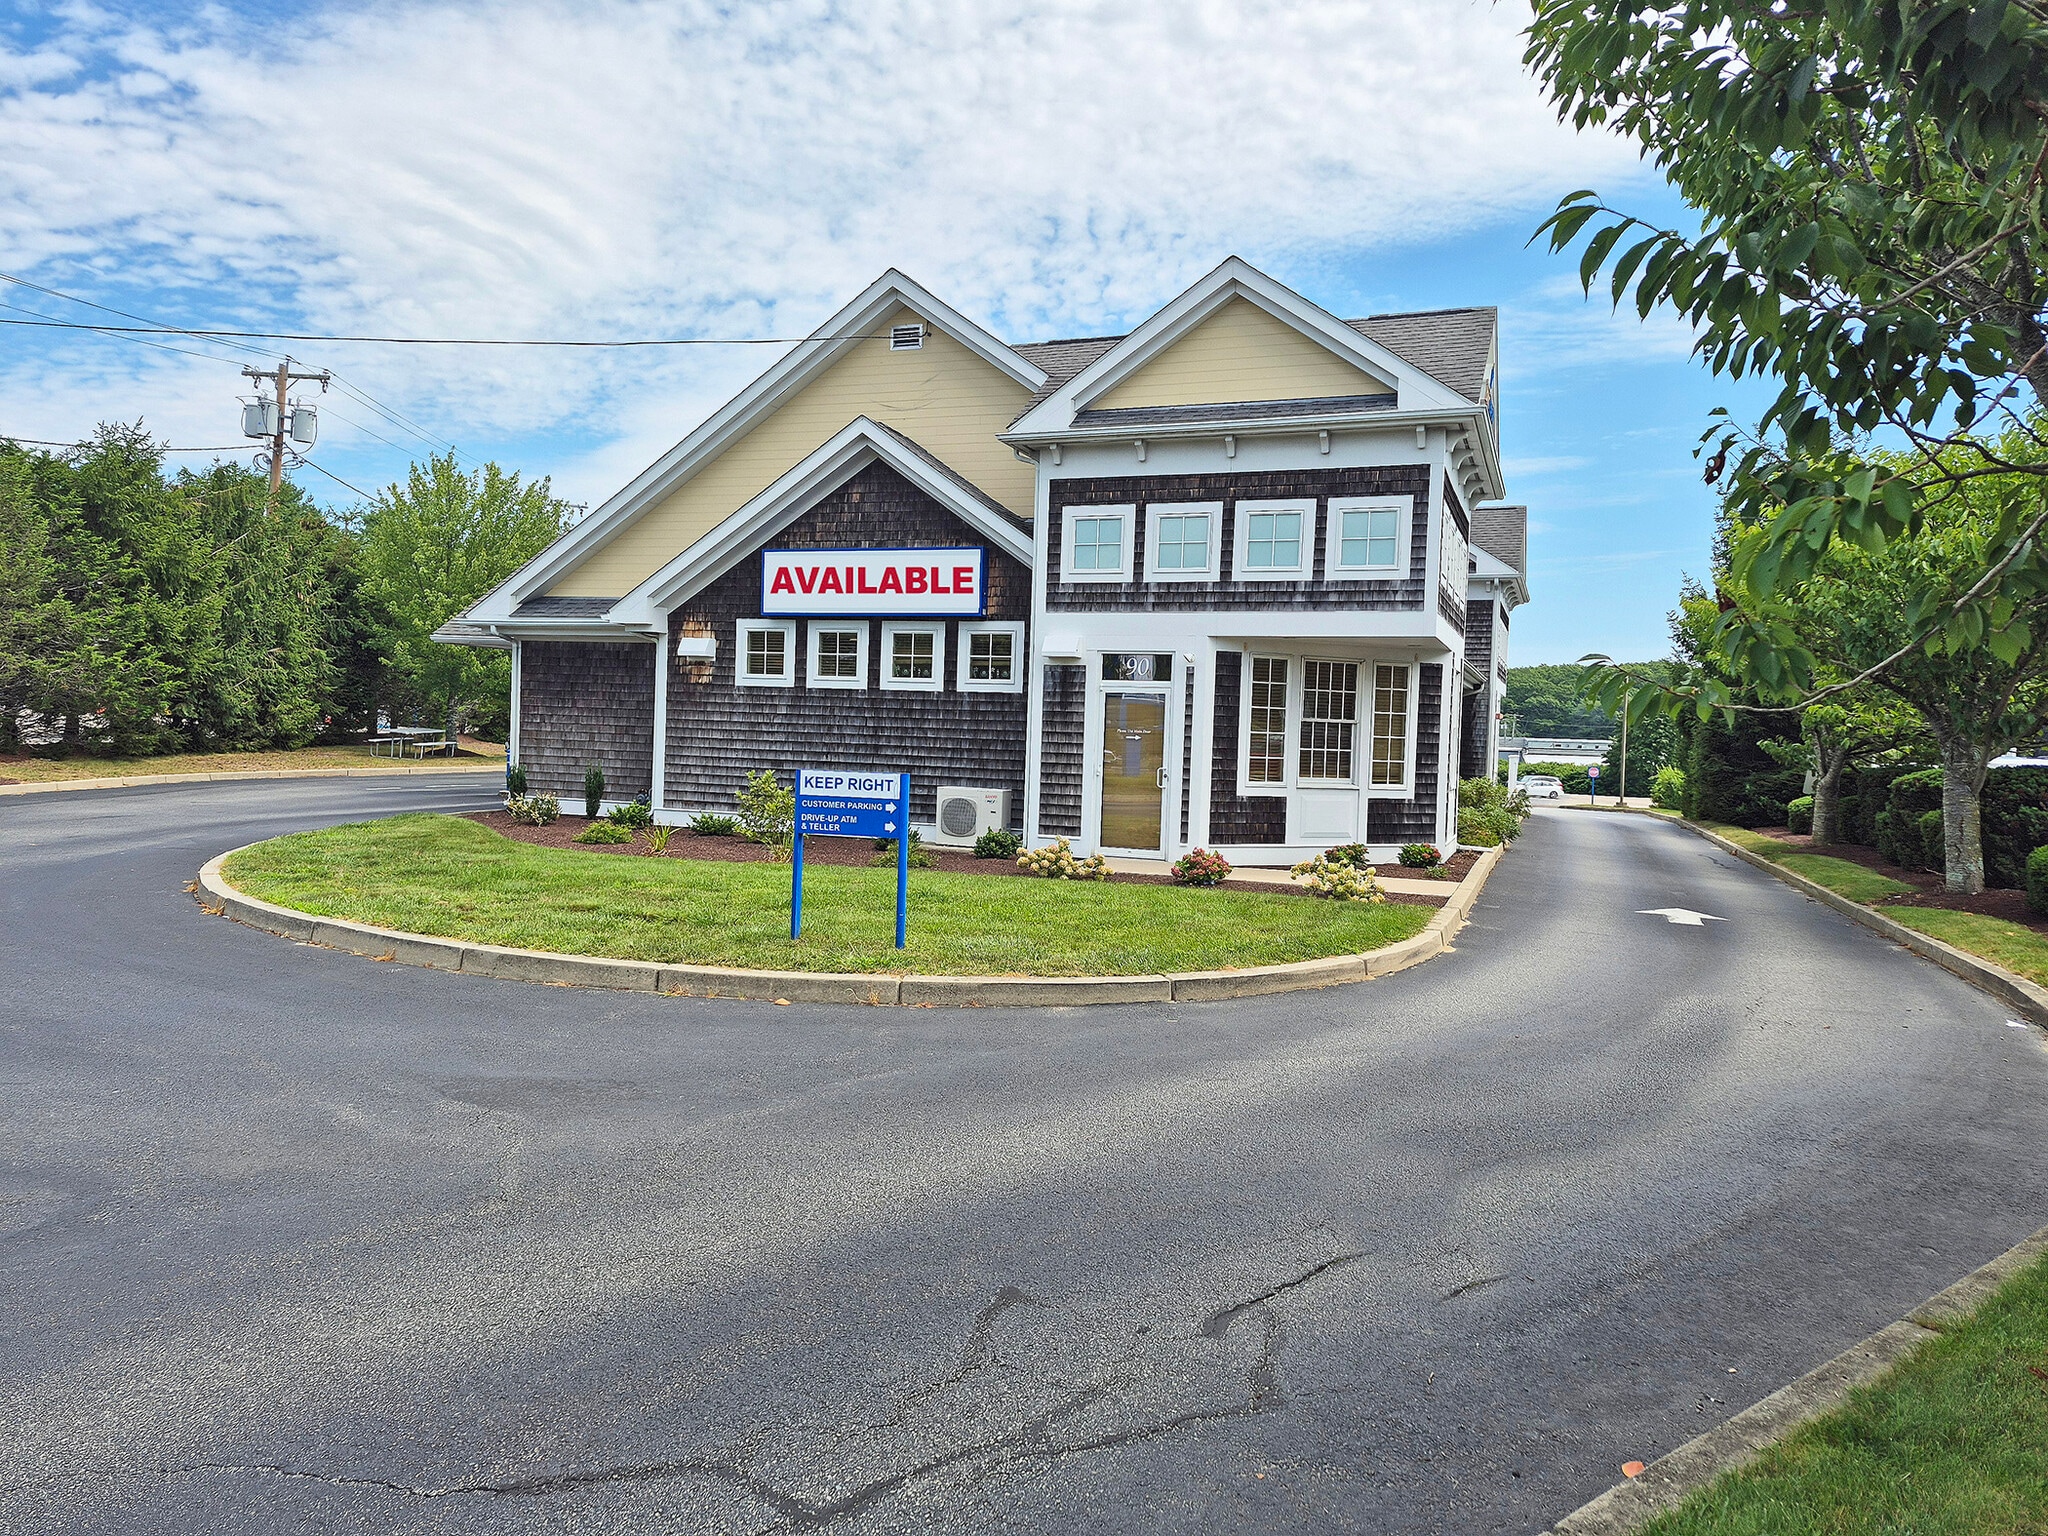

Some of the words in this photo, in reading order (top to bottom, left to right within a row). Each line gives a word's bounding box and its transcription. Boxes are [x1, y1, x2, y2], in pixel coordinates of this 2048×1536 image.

[770, 566, 974, 594] AVAILABLE
[1125, 657, 1149, 676] 90
[804, 776, 844, 789] KEEP
[848, 778, 894, 791] RIGHT
[801, 800, 846, 809] CUSTOMER
[847, 802, 883, 811] PARKING
[801, 813, 839, 823] DRIVE-UP
[809, 823, 840, 831] TELLER
